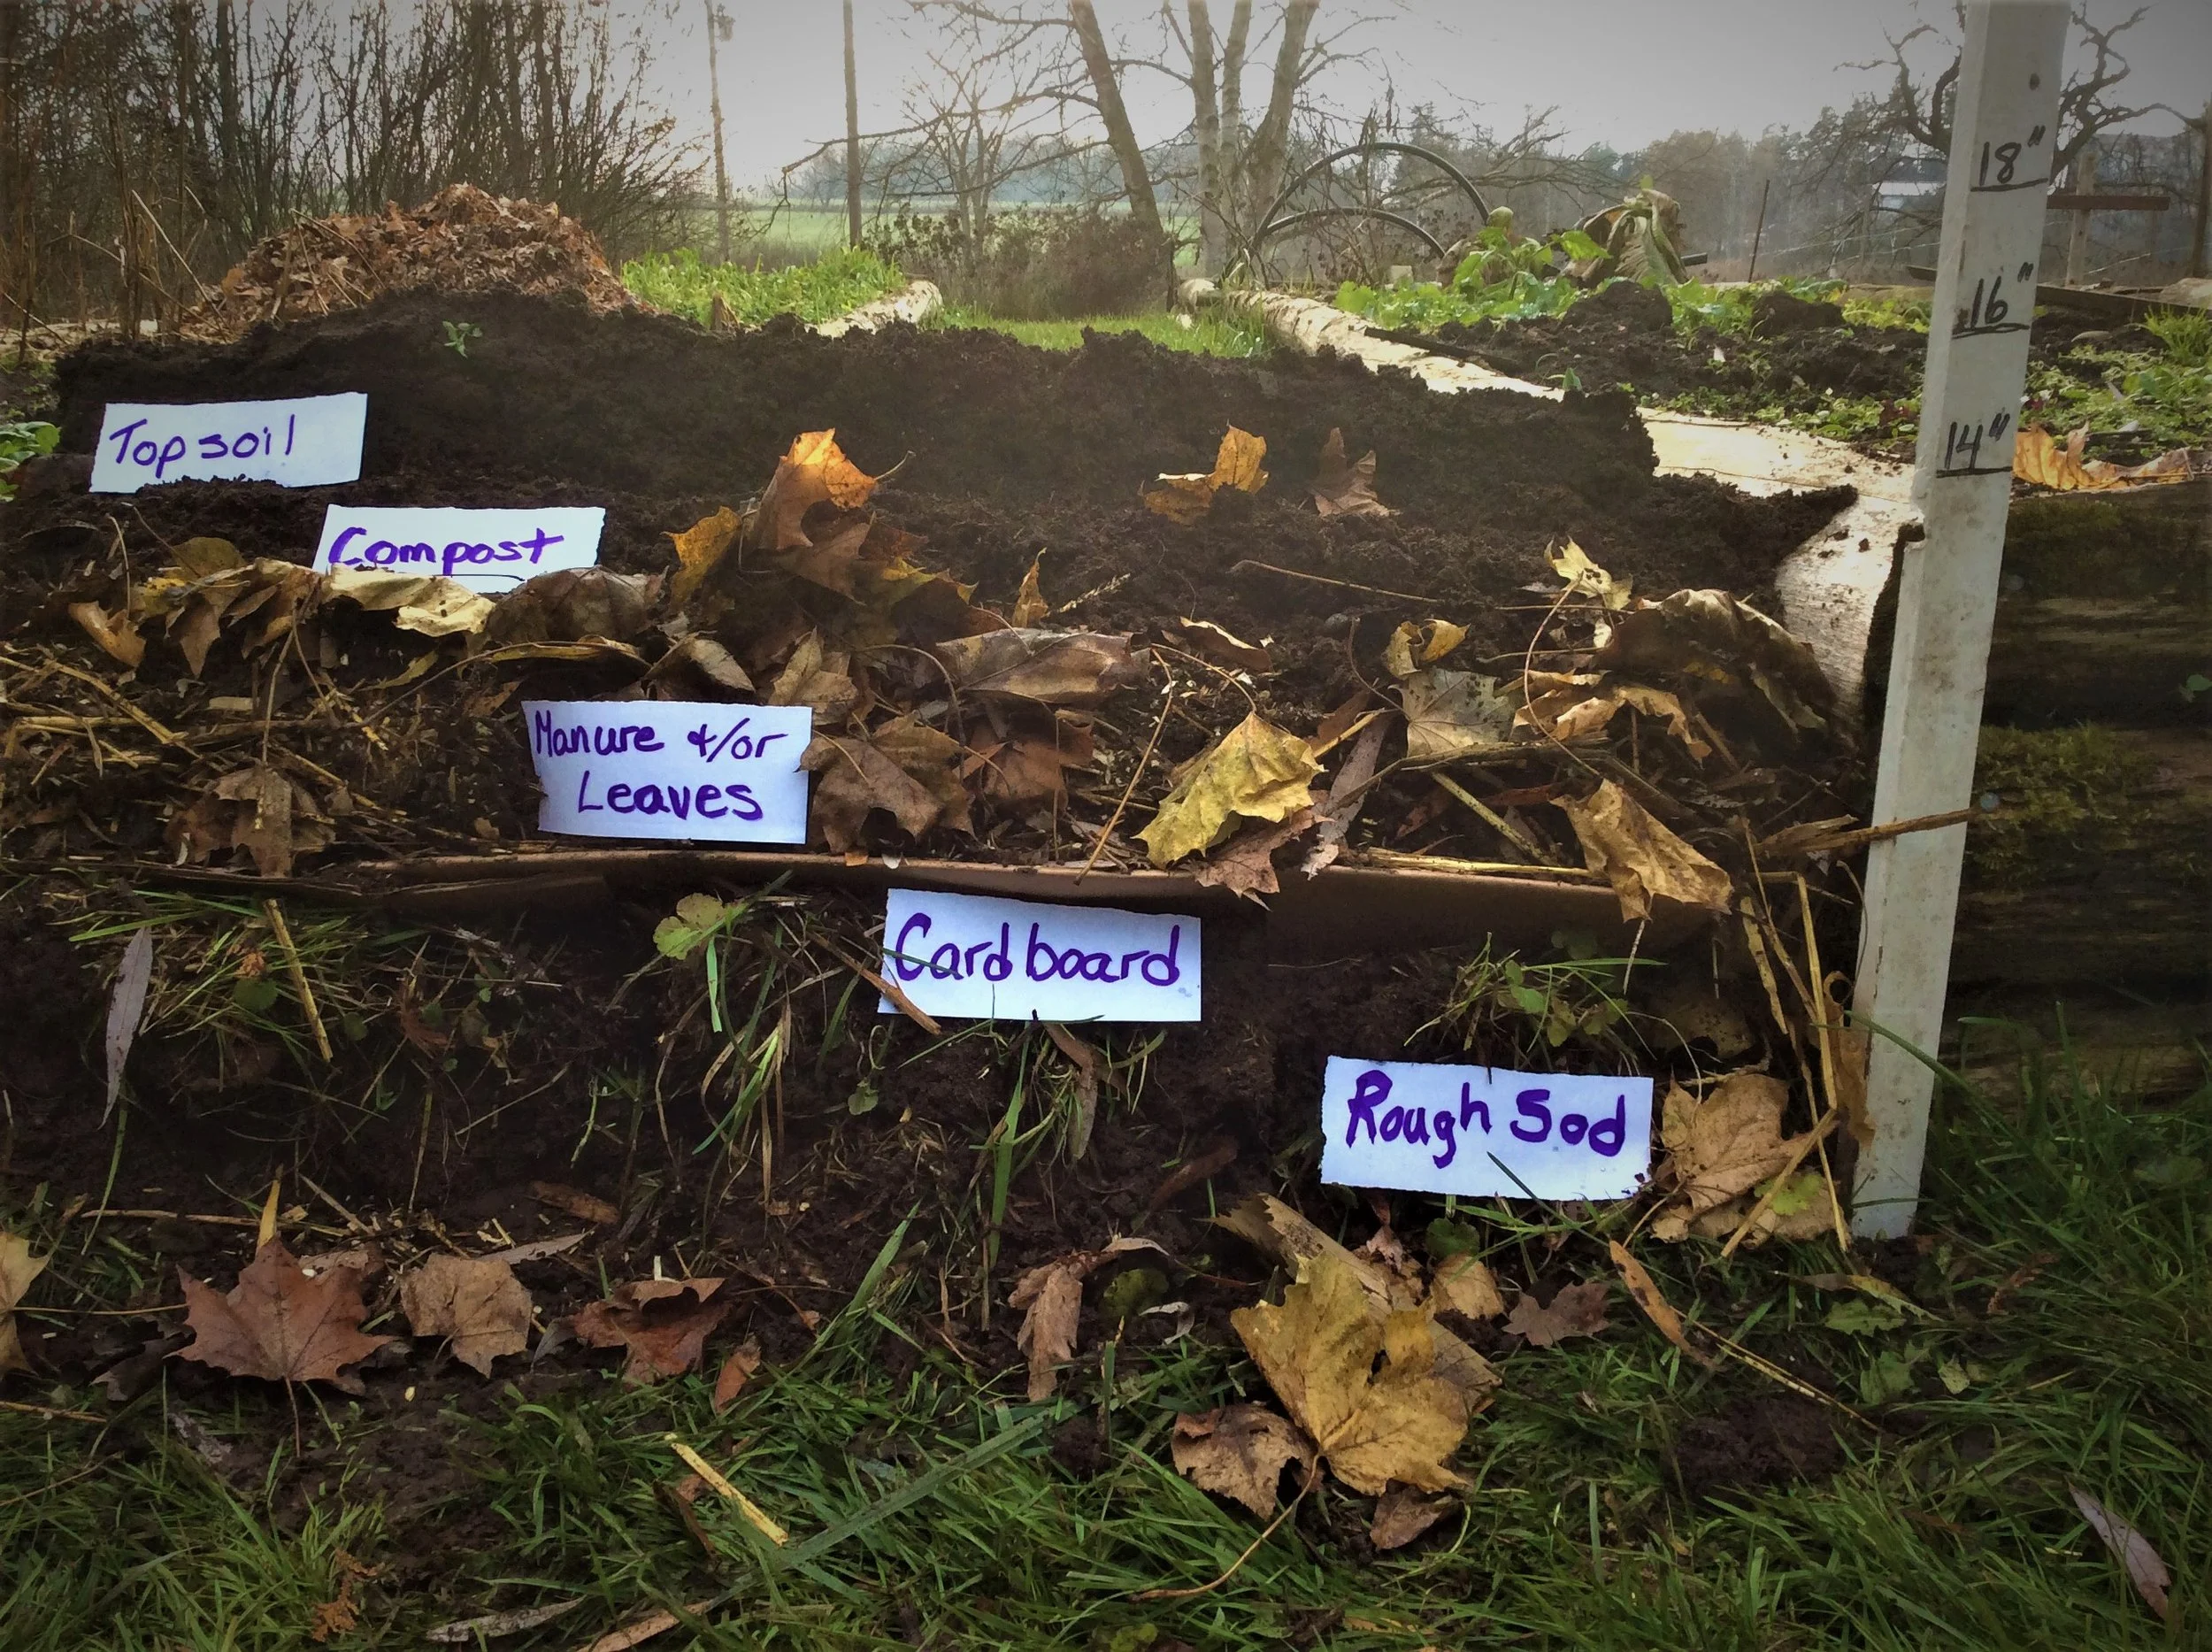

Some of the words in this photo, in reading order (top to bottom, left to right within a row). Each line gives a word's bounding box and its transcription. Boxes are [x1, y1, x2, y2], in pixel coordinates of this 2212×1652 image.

[1978, 125, 2047, 187] 18"
[1970, 261, 2034, 331] 16"
[1944, 412, 2011, 470] 14"
[327, 526, 565, 580] Compost
[534, 710, 664, 757] Manure
[578, 770, 764, 821] Leaves
[895, 912, 1181, 987] Cardboard
[1345, 1069, 1494, 1170] Rough
[1509, 1088, 1626, 1157] Sod
